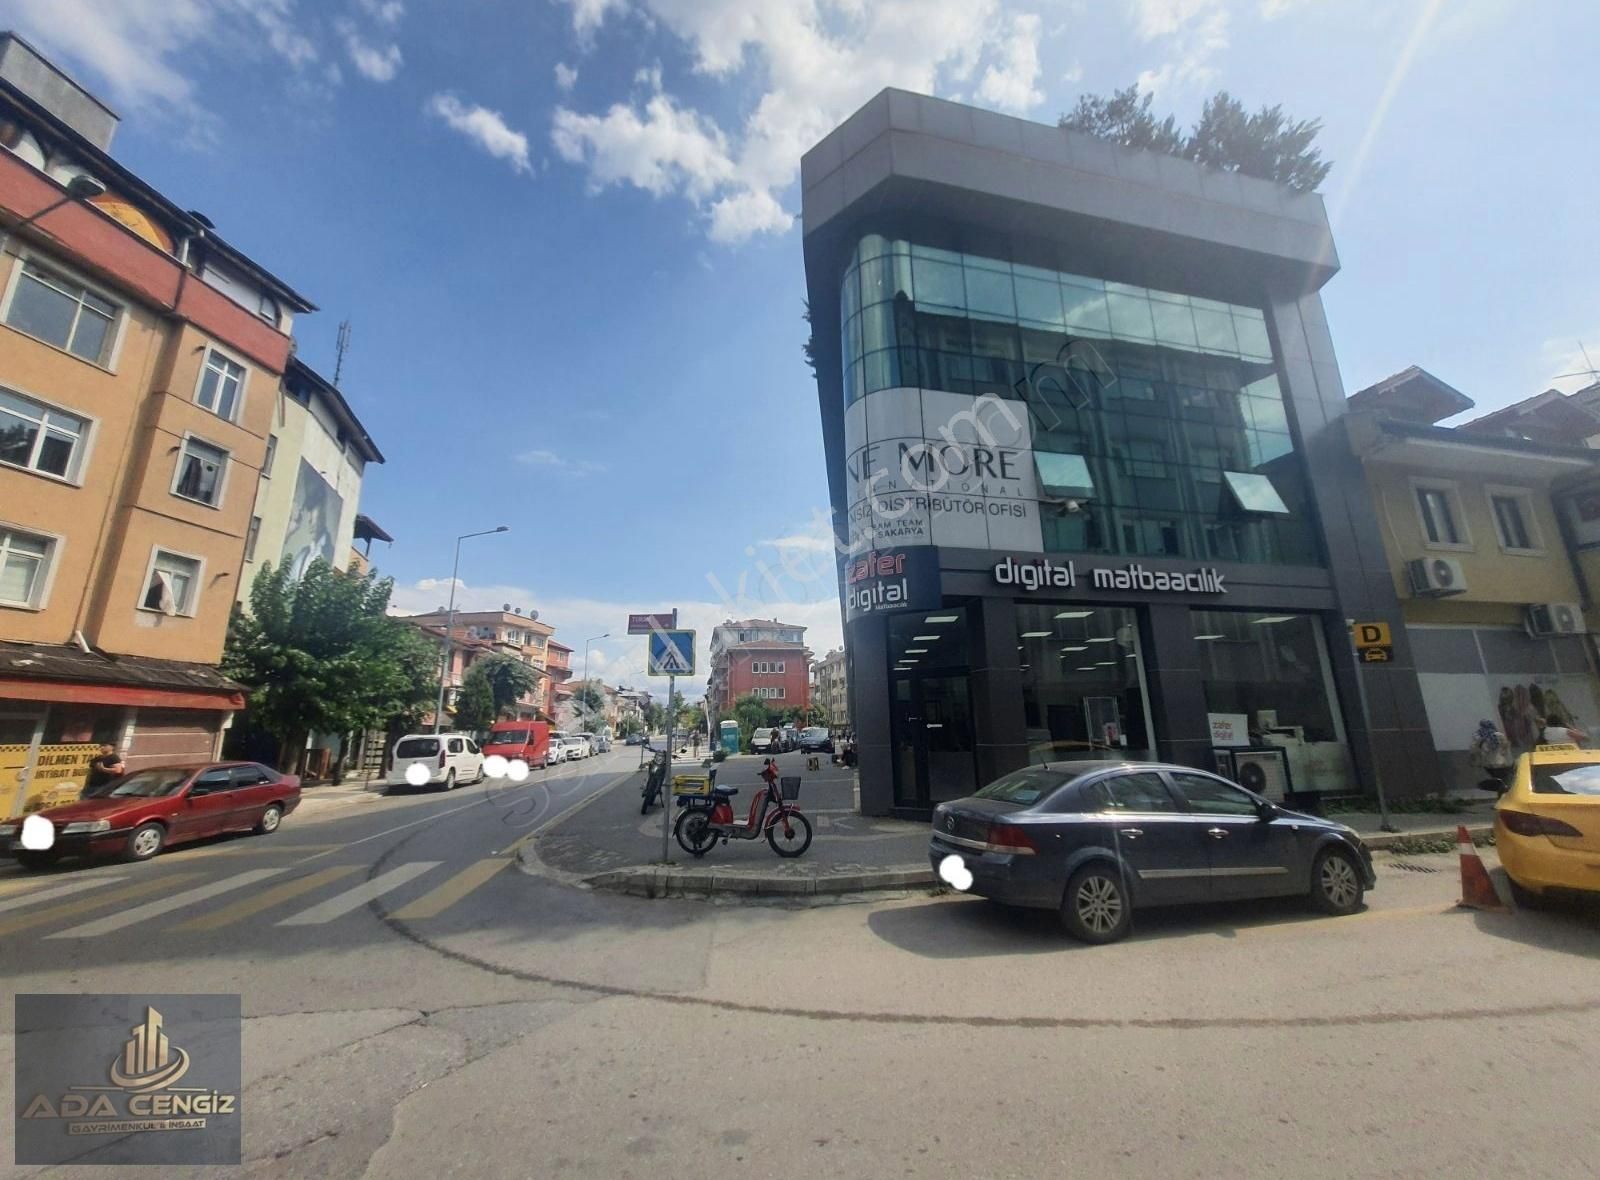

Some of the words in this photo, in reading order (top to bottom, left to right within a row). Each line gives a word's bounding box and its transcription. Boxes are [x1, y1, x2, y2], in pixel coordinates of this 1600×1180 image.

[898, 442, 1021, 480] MORE
[878, 527, 923, 539] SAKARYA
[896, 519, 923, 528] TEAM
[847, 551, 905, 584] zafer
[995, 556, 1076, 591] digital
[1092, 563, 1228, 593] matbaacılık
[848, 577, 908, 612] digital
[1362, 625, 1382, 643] D
